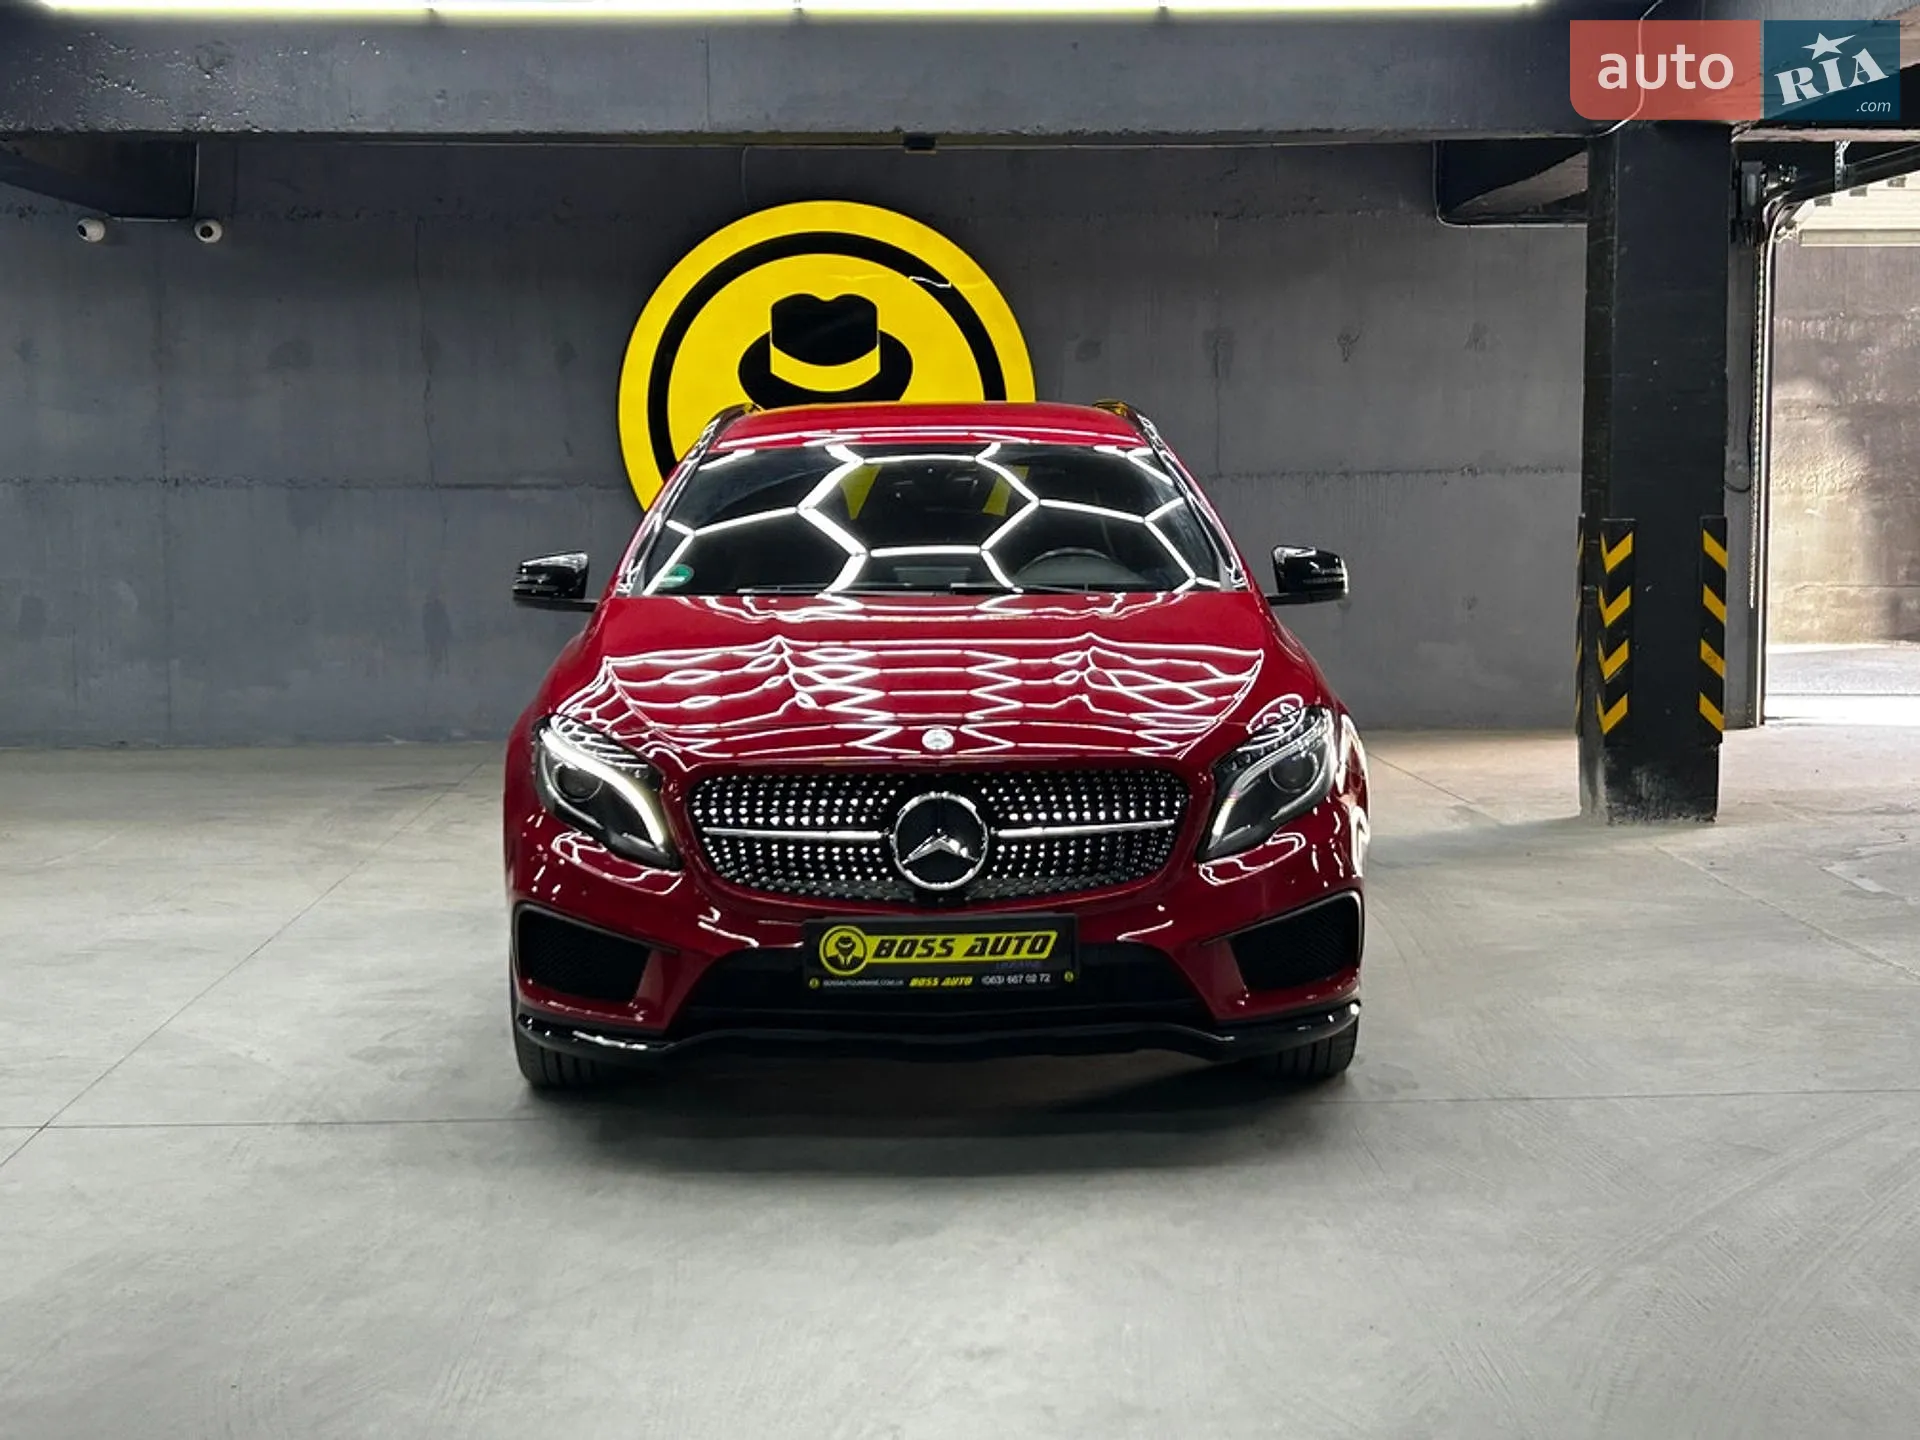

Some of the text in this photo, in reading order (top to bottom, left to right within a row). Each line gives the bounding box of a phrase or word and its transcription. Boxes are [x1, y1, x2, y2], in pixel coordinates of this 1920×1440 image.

[872, 935, 1051, 959] BOSS AUTO
[909, 976, 974, 987] BOSS AUTO
[1039, 972, 1051, 983] 72
